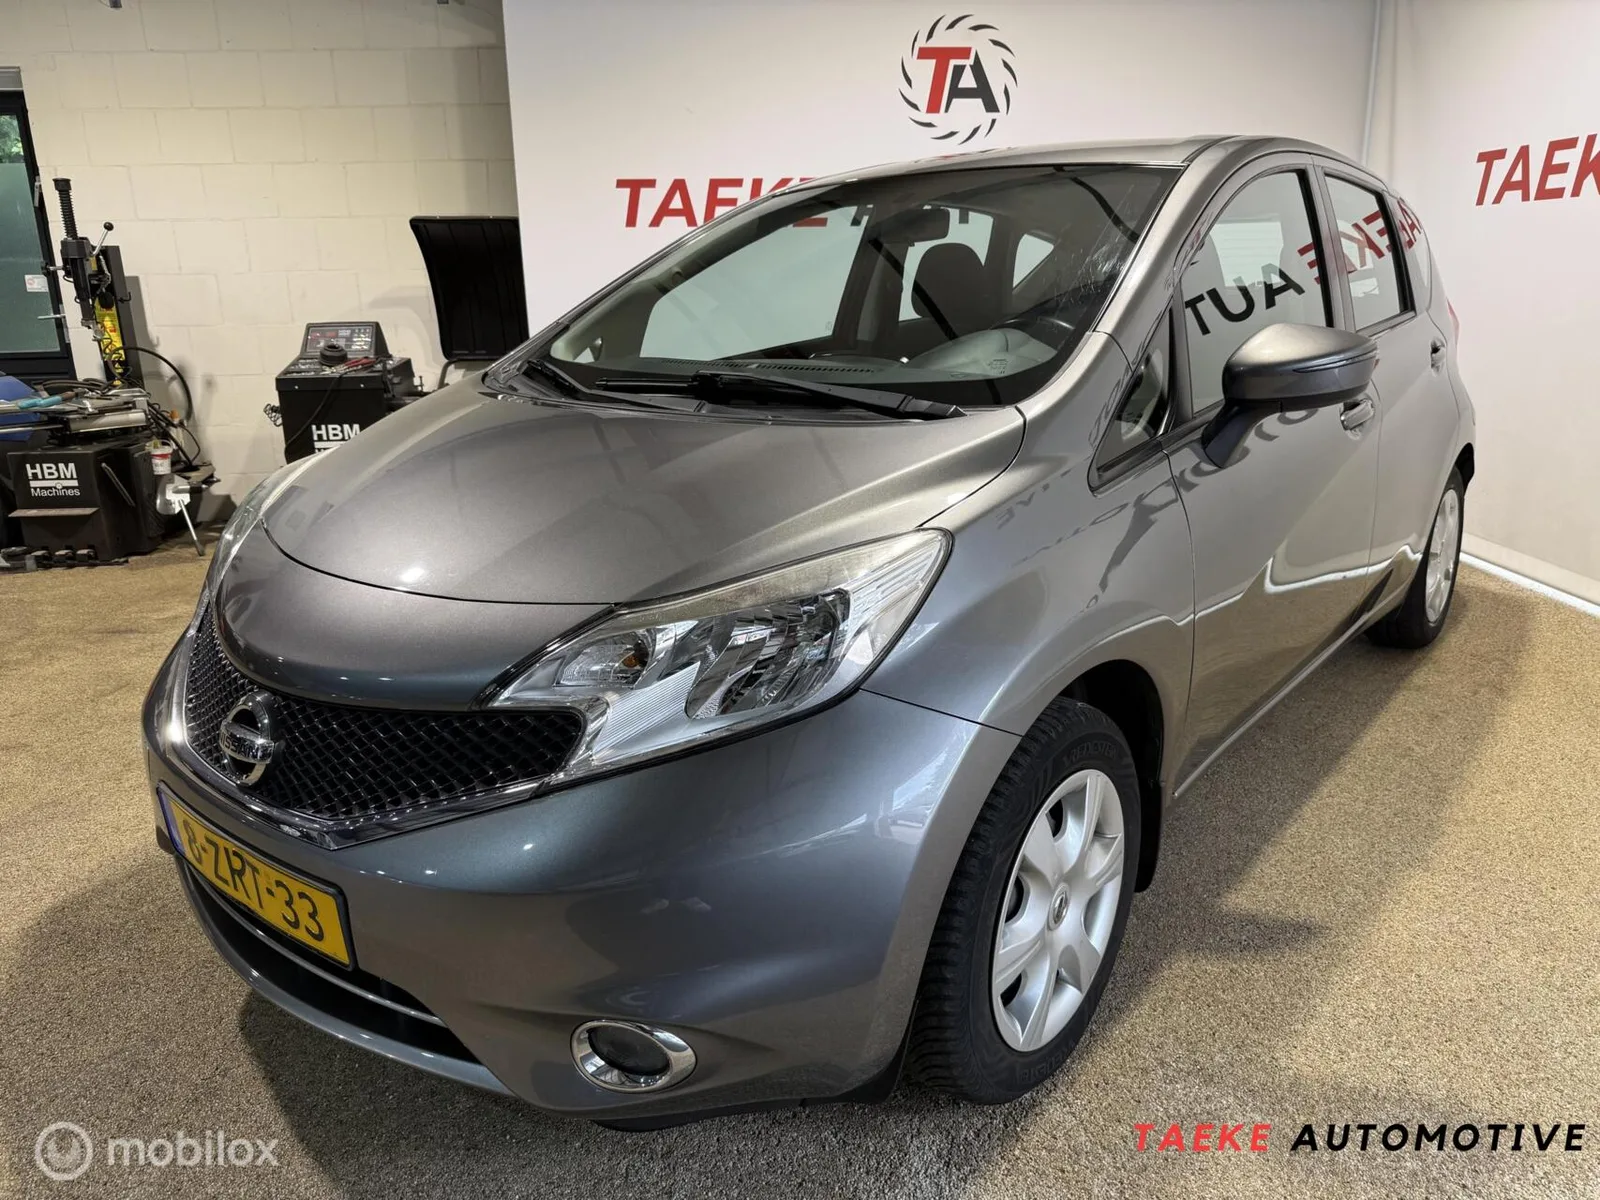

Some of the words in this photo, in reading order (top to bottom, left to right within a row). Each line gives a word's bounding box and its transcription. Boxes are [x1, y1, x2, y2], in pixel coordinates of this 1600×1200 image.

[917, 46, 1001, 114] TA
[312, 424, 361, 441] HBM
[25, 462, 77, 480] HBM
[30, 487, 81, 498] Machines
[183, 819, 325, 943] 8-ZRT-33
